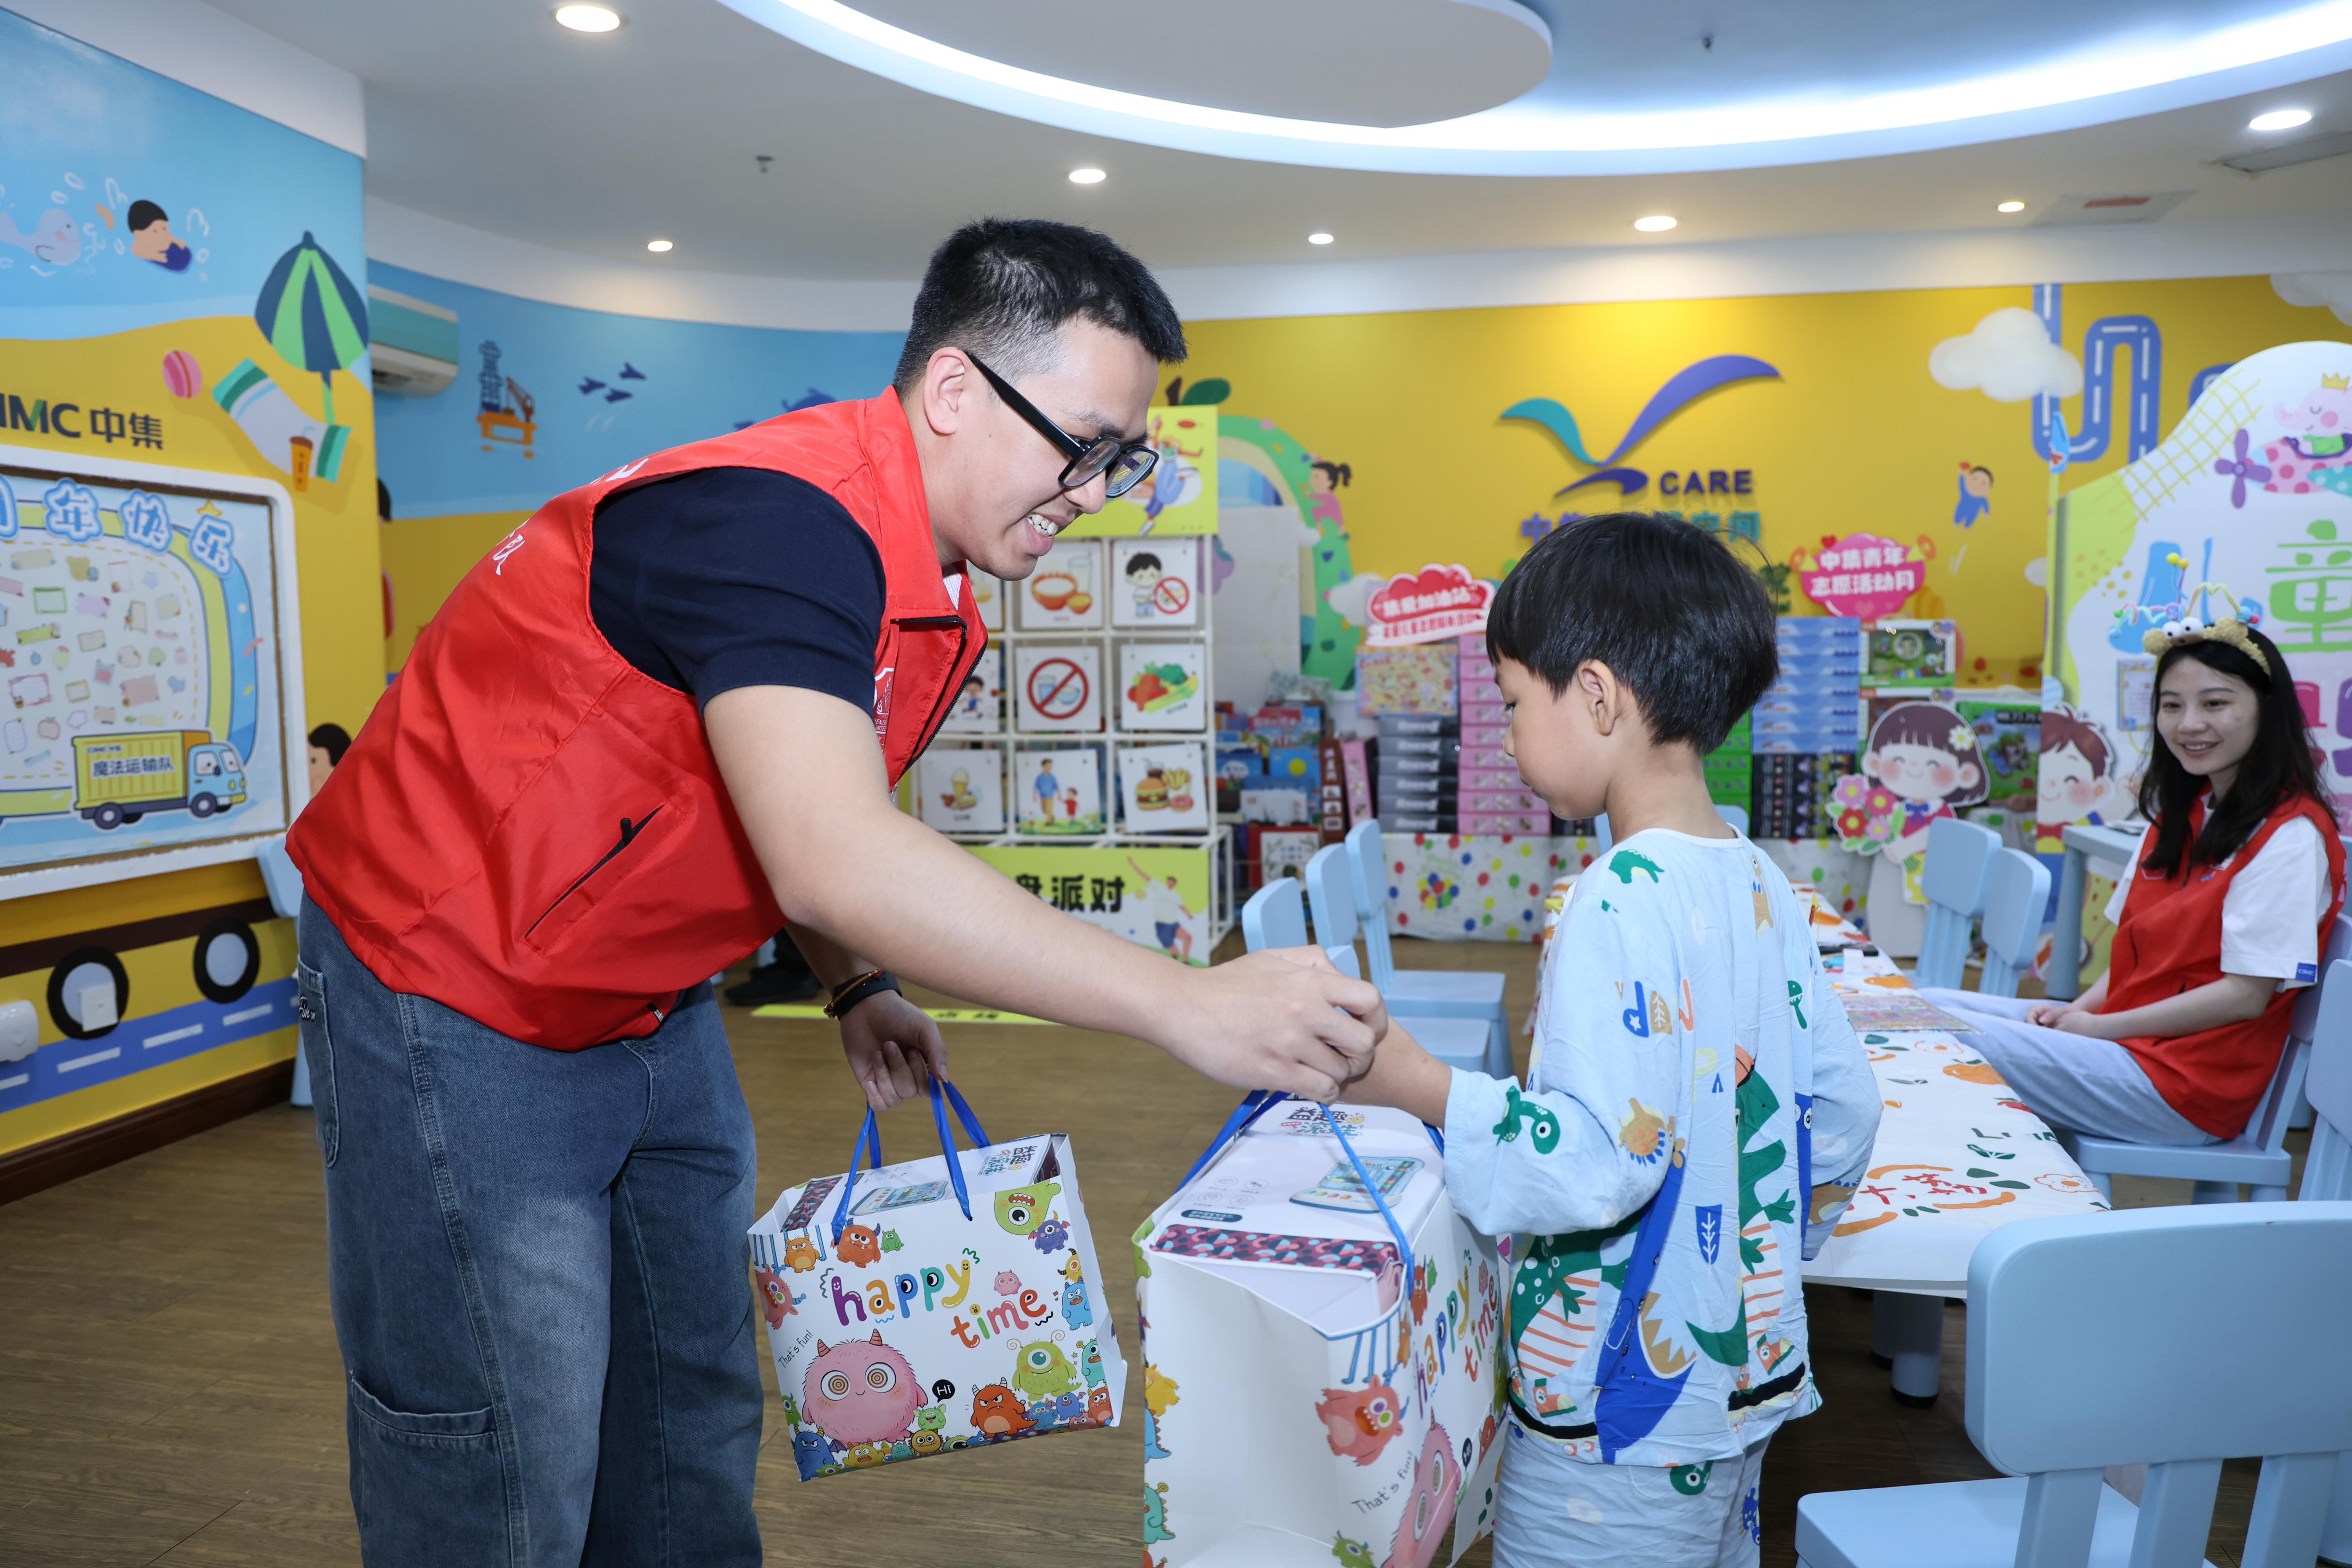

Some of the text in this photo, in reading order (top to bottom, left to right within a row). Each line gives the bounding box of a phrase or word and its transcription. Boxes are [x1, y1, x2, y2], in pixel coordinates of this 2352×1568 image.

[90, 408, 163, 450] 中集
[1661, 470, 1751, 495] CARE
[0, 475, 234, 578] 年快乐
[1819, 546, 1904, 571] 中集青年
[1810, 570, 1915, 597] 志愿活动月
[93, 755, 175, 777] 魔法运输队
[831, 1259, 970, 1326] happy
[951, 1289, 1047, 1348] time
[1465, 1276, 1497, 1382] time
[778, 1329, 813, 1368] That's fun!
[1415, 1265, 1469, 1420] happy
[937, 1385, 951, 1396] Hi
[1350, 1483, 1399, 1514] That's
